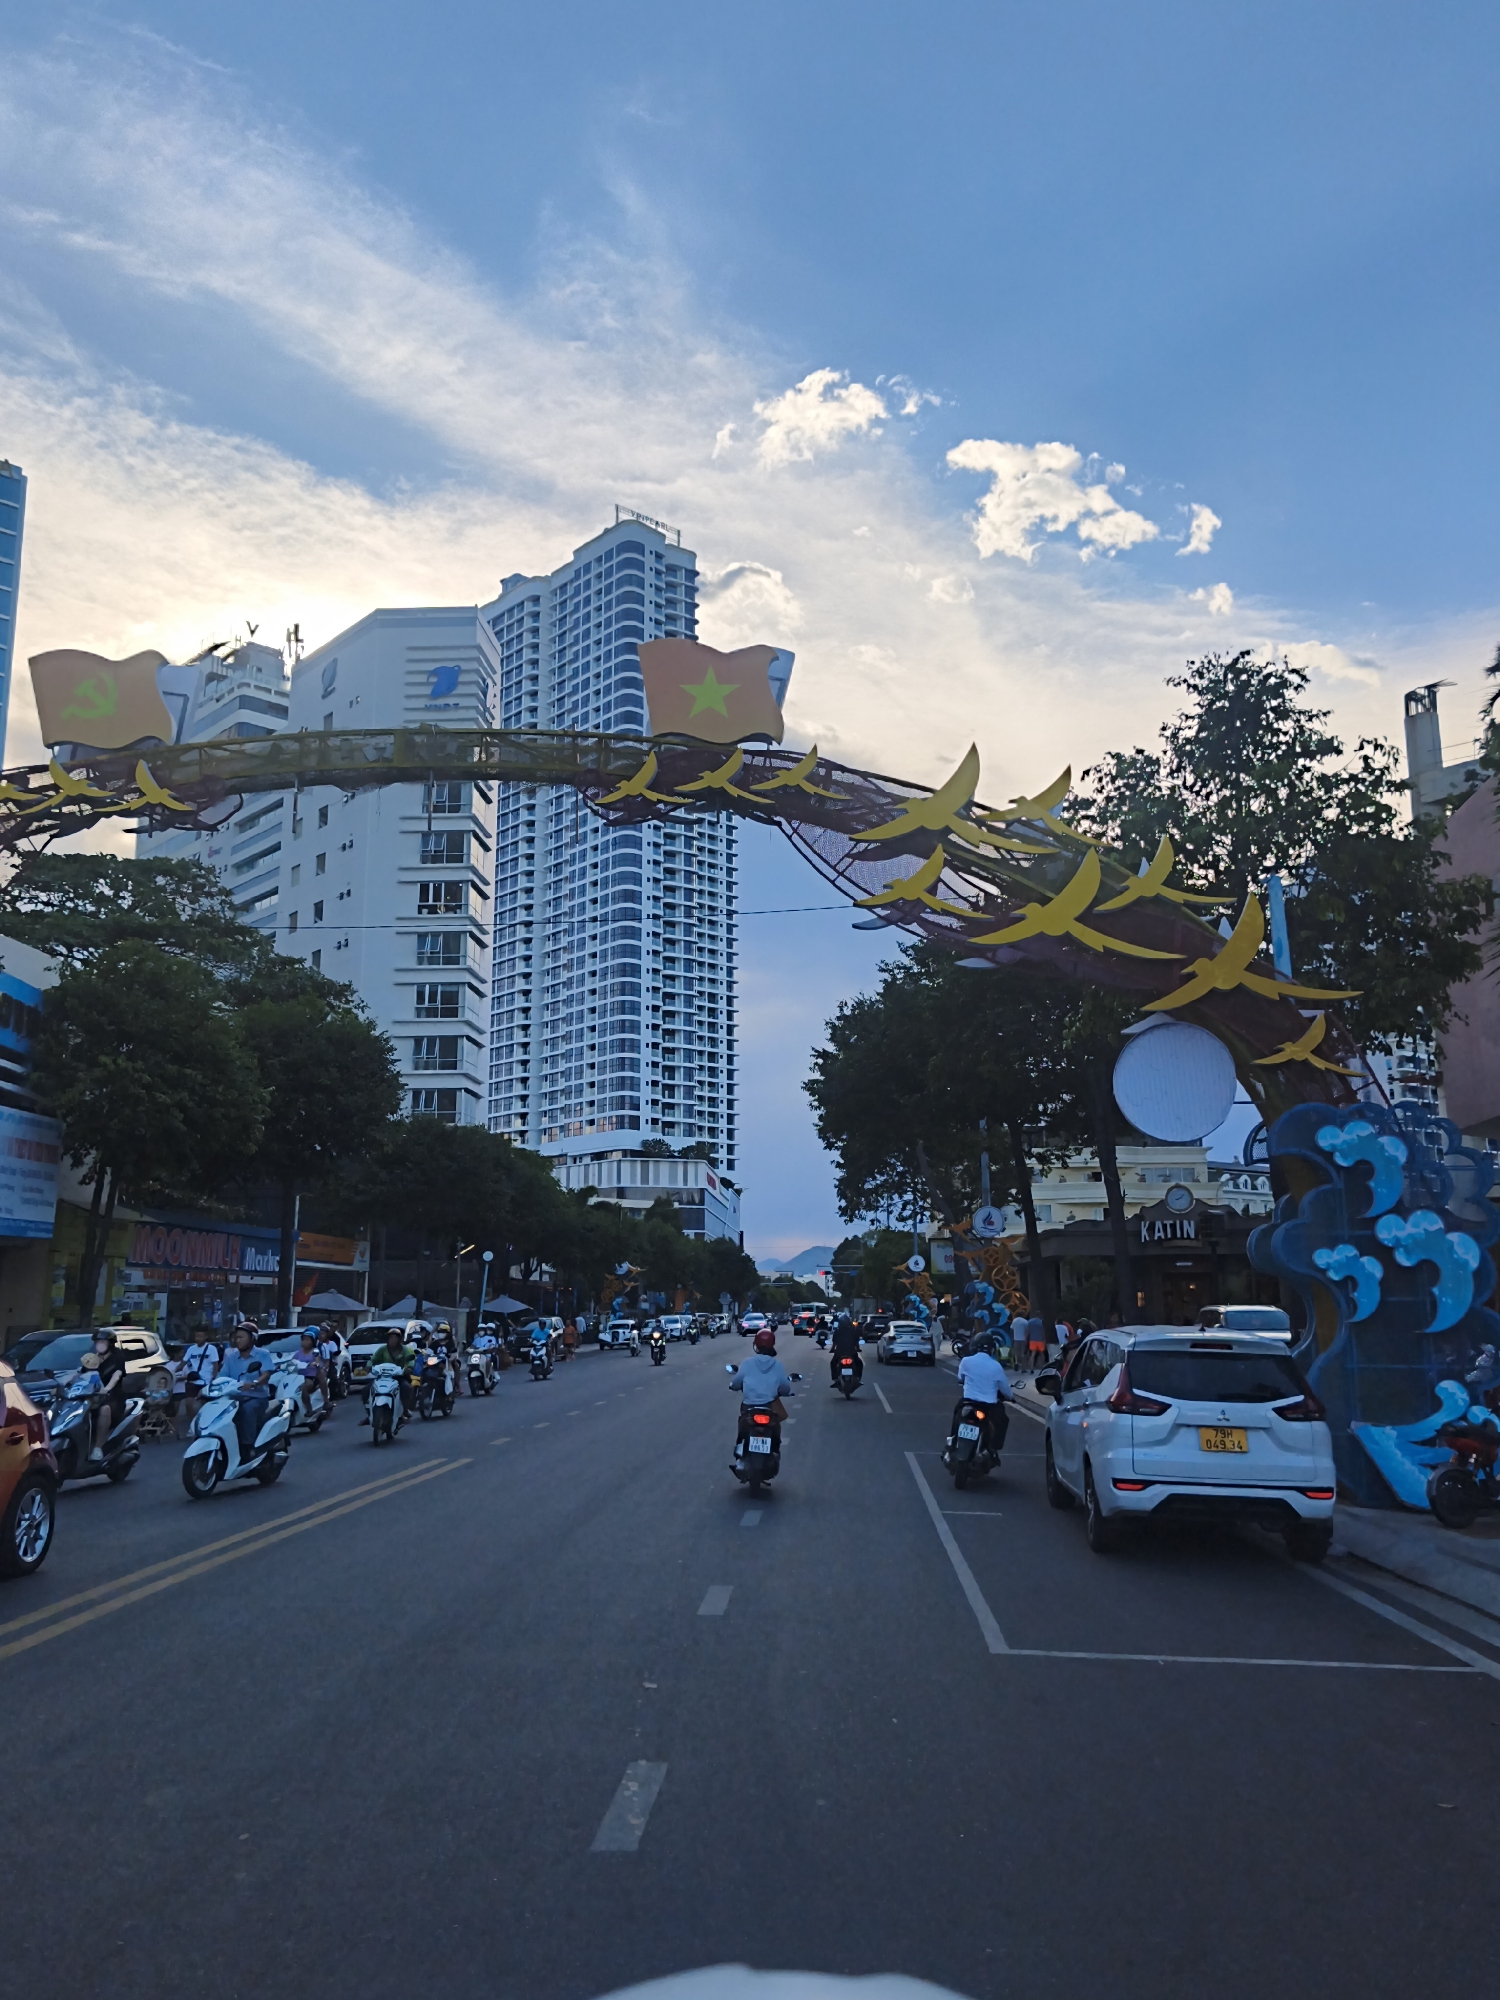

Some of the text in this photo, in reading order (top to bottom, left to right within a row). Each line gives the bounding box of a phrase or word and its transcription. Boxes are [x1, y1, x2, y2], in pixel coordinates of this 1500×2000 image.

[1141, 1219, 1195, 1243] KATIN
[128, 1224, 242, 1271] MOONMILK
[1212, 1428, 1233, 1439] 79H
[1205, 1438, 1243, 1450] 049.34
